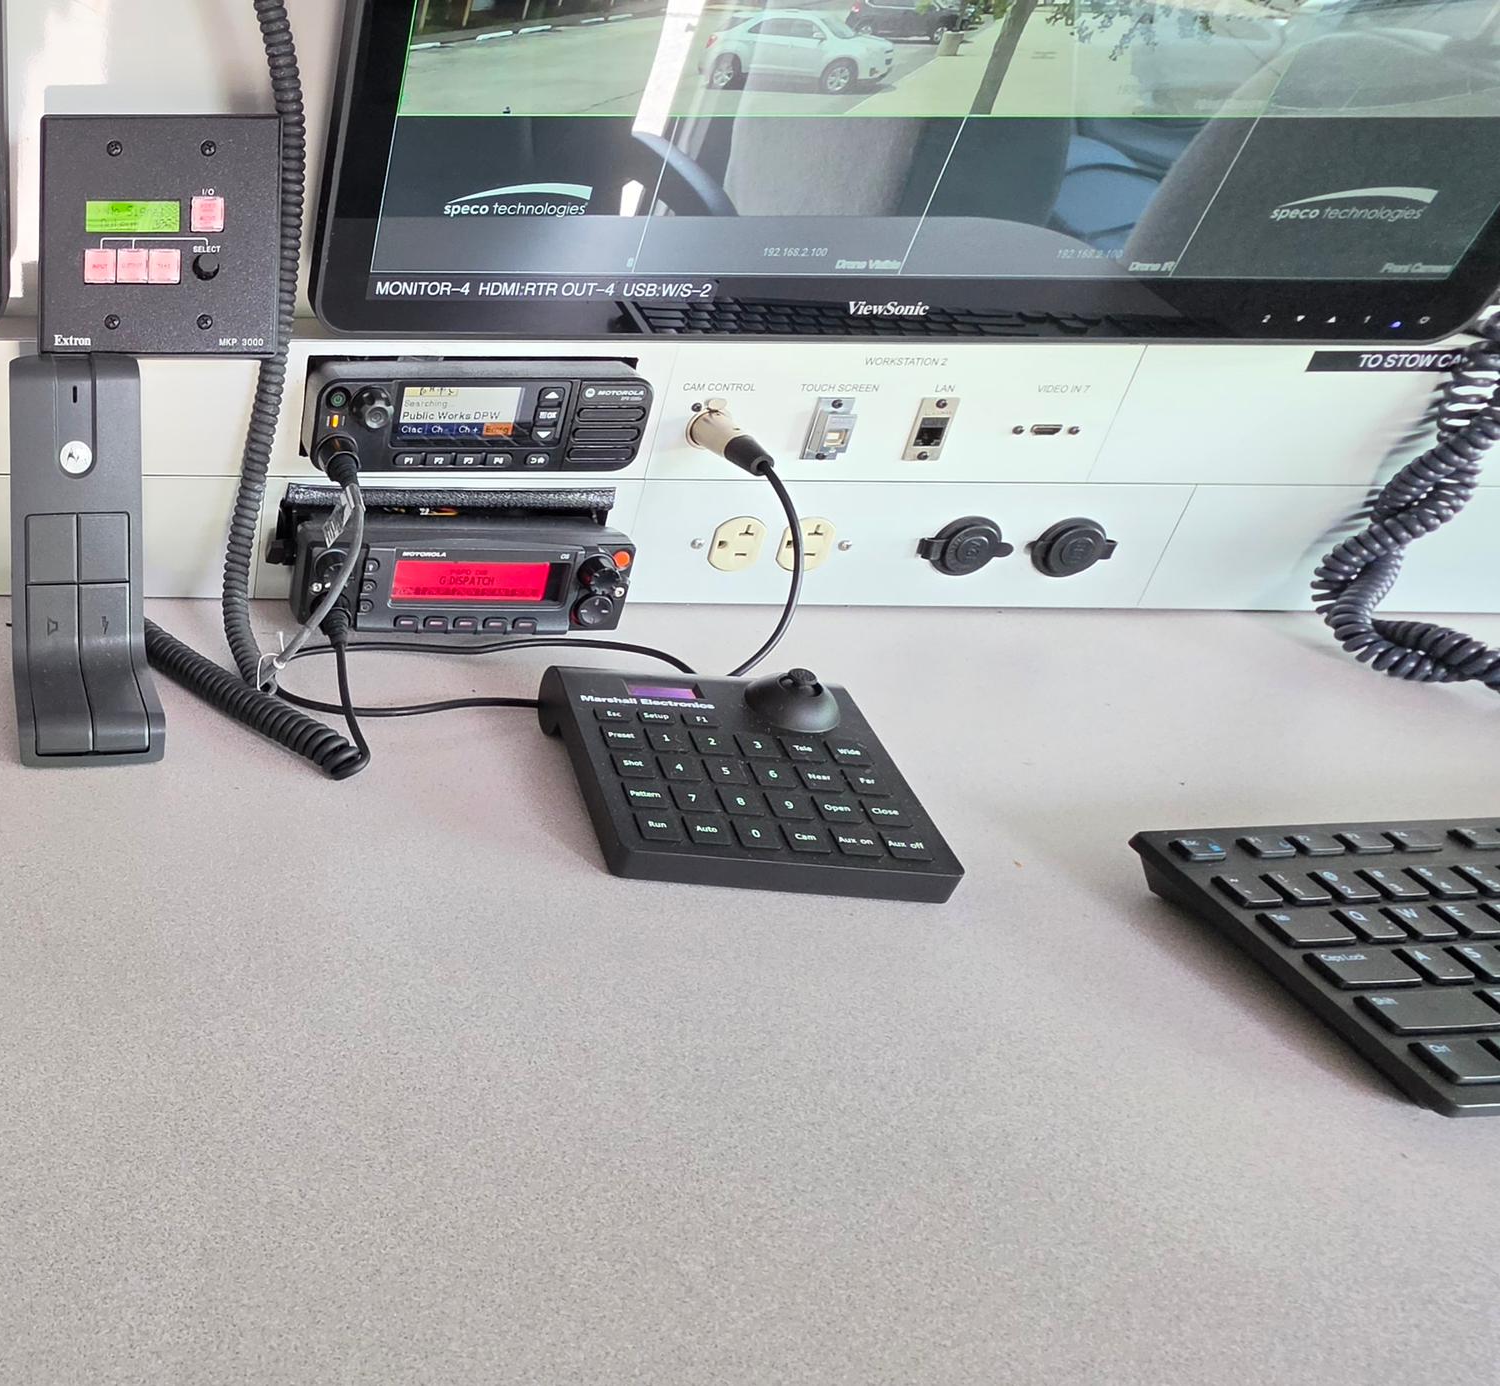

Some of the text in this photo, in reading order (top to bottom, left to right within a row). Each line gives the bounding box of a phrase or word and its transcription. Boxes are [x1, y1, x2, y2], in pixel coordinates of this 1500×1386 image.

[202, 188, 215, 196] I/O
[444, 201, 586, 217] speco technologies
[1270, 206, 1423, 222] speco technologies
[376, 281, 712, 299] MONITOR-4 HDMI:RTR OUT-4 USB:W/S-2
[848, 301, 930, 316] ViewSonic
[54, 335, 91, 346] Extron
[219, 338, 264, 346] MKP 3000
[864, 358, 948, 366] WORKSTATION 2
[1358, 354, 1383, 368] TO
[1384, 354, 1437, 368] STOW
[682, 383, 756, 392] CAM CONTROL
[800, 384, 880, 393] TOUCH SCREEN
[934, 384, 955, 393] LAN
[1037, 384, 1068, 393] VIDEO
[1070, 384, 1081, 393] IN
[402, 412, 501, 420] Public Works DPW
[404, 457, 414, 465] P1
[434, 457, 444, 465] P2
[463, 457, 474, 465] P3
[493, 457, 504, 465] P4
[580, 694, 715, 710] Marshall Electronics
[606, 710, 622, 718] Esc
[643, 712, 670, 722] Setup
[608, 731, 635, 740] Preset
[708, 738, 717, 746] 2
[753, 741, 762, 750] 3
[622, 759, 644, 768] Shot
[676, 763, 684, 772] 4
[722, 766, 730, 775] 5
[768, 770, 778, 779] 6
[808, 773, 831, 782] Near
[629, 790, 661, 799] Pattern
[688, 794, 697, 802] 7
[736, 798, 746, 806] 8
[784, 800, 794, 810] 9
[824, 804, 851, 815] Open
[872, 807, 899, 816] Close
[648, 820, 667, 830] Run
[696, 825, 718, 834] Auto
[752, 829, 761, 839] 0
[794, 832, 817, 842] Cam
[838, 836, 873, 846] Aux on
[888, 840, 907, 850] Aux
[1348, 910, 1369, 922] Q
[1396, 908, 1419, 919] W
[1414, 951, 1431, 961] A
